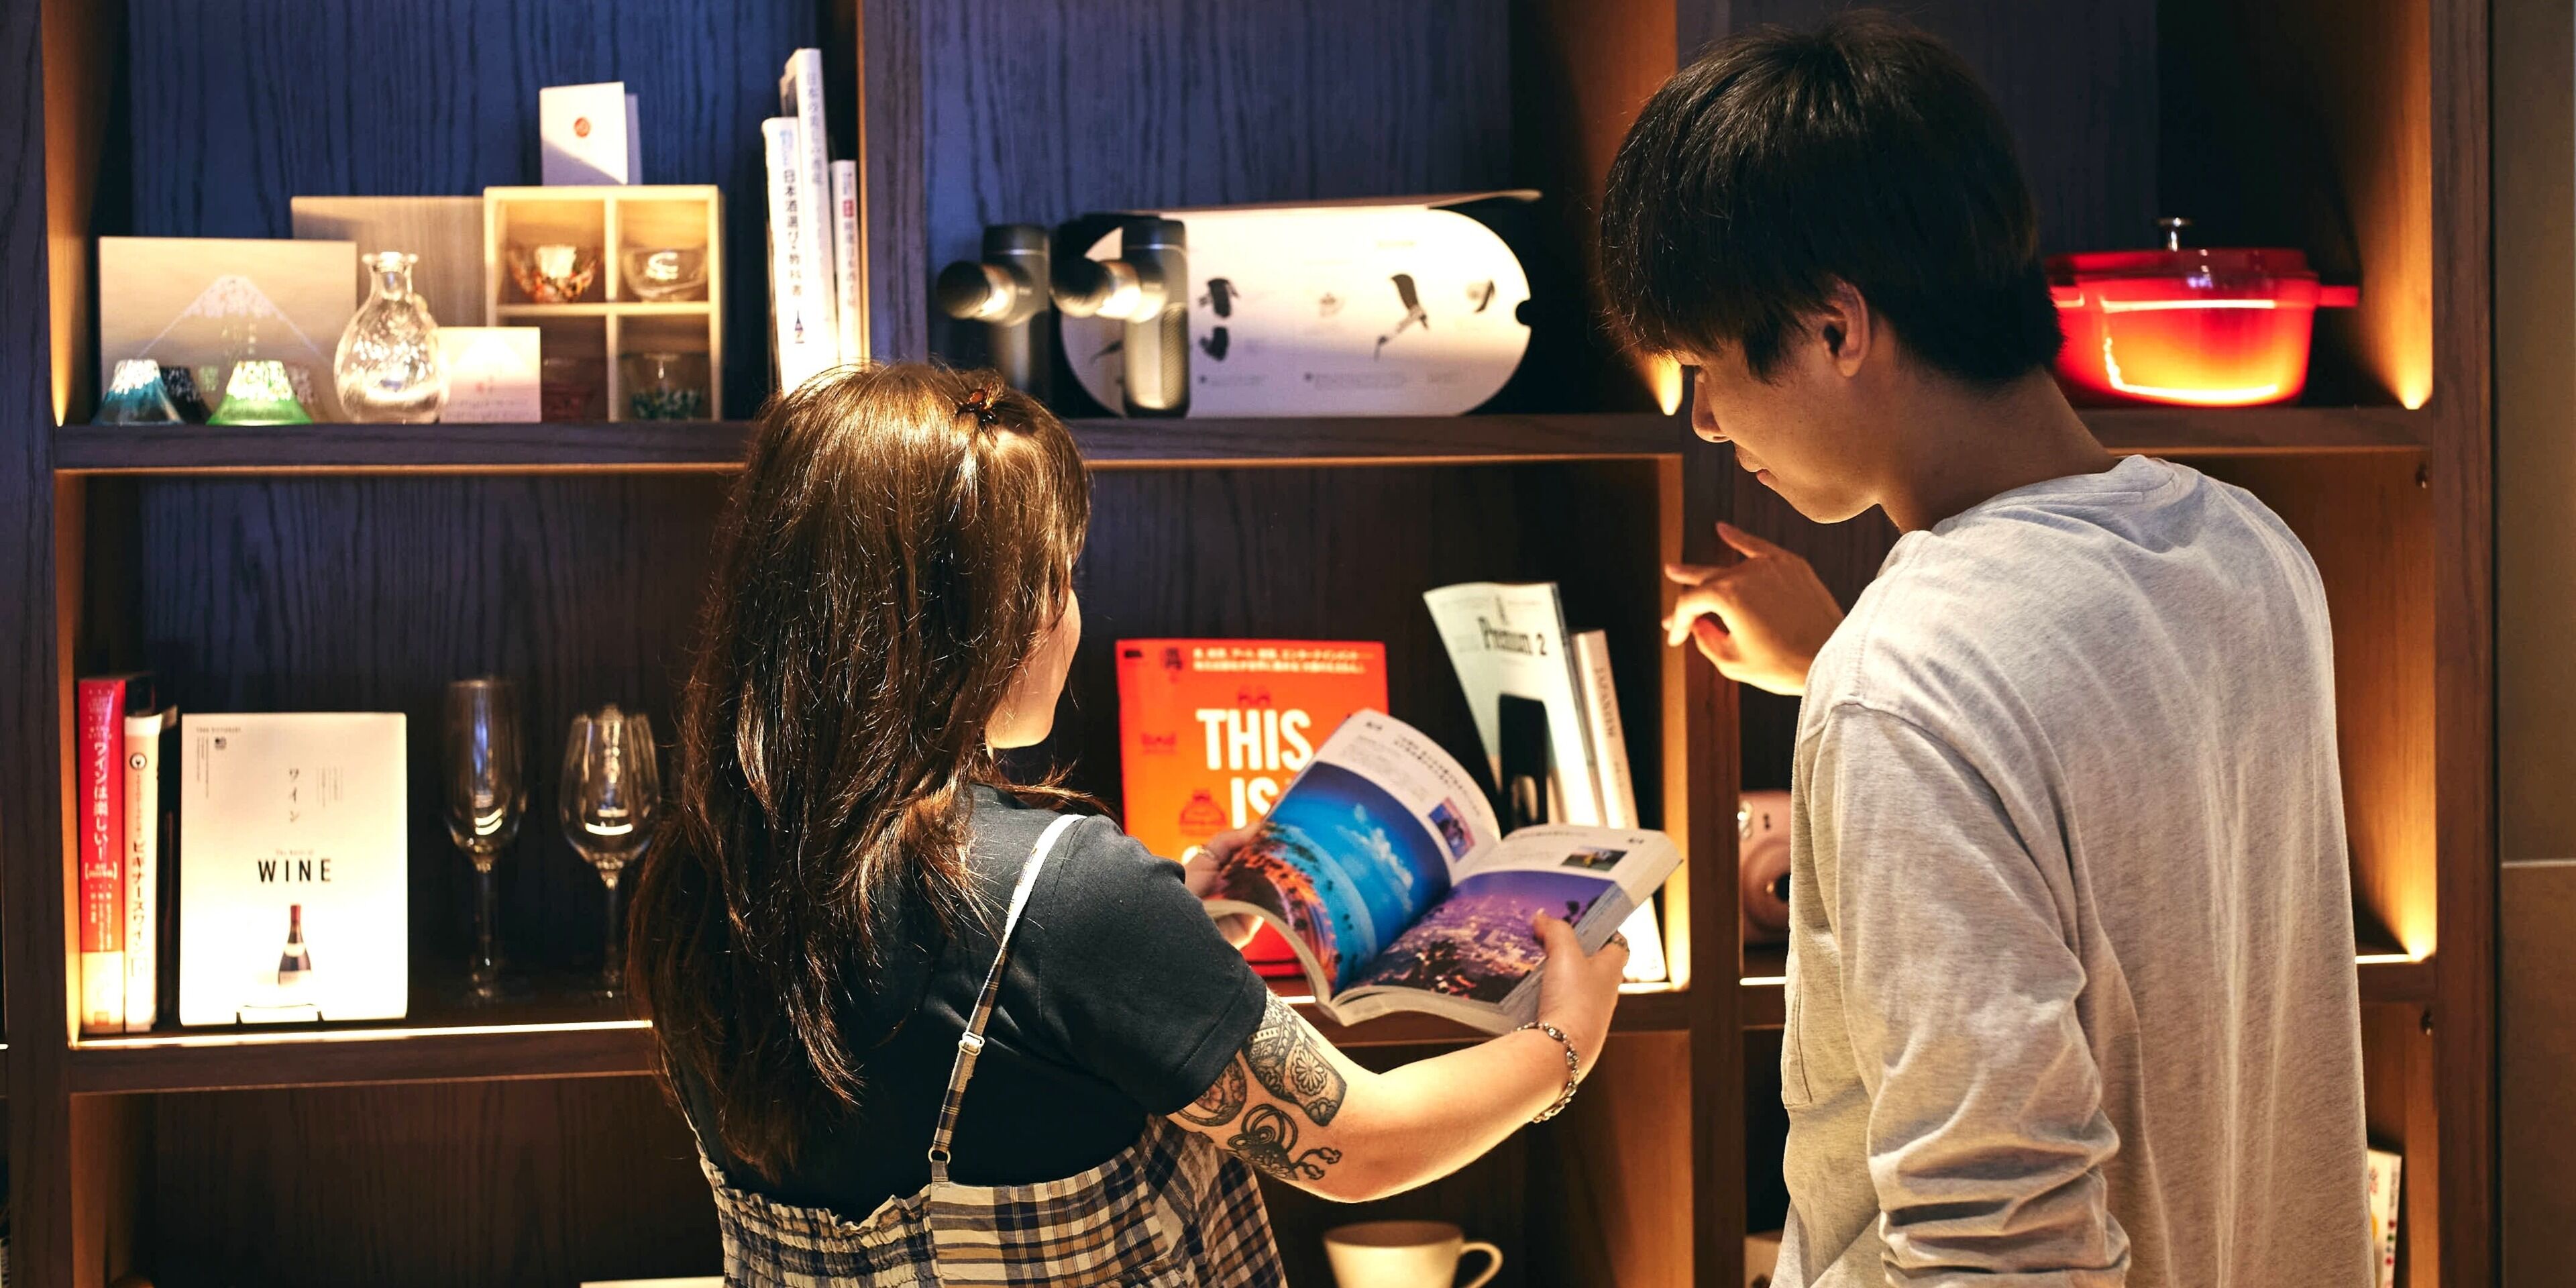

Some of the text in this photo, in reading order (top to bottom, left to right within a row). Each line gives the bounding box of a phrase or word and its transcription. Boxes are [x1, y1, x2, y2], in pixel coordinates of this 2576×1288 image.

[1536, 632, 1548, 656] 2
[1195, 708, 1313, 771] THIS
[288, 767, 300, 824] ワイン
[257, 858, 332, 883] WINE
